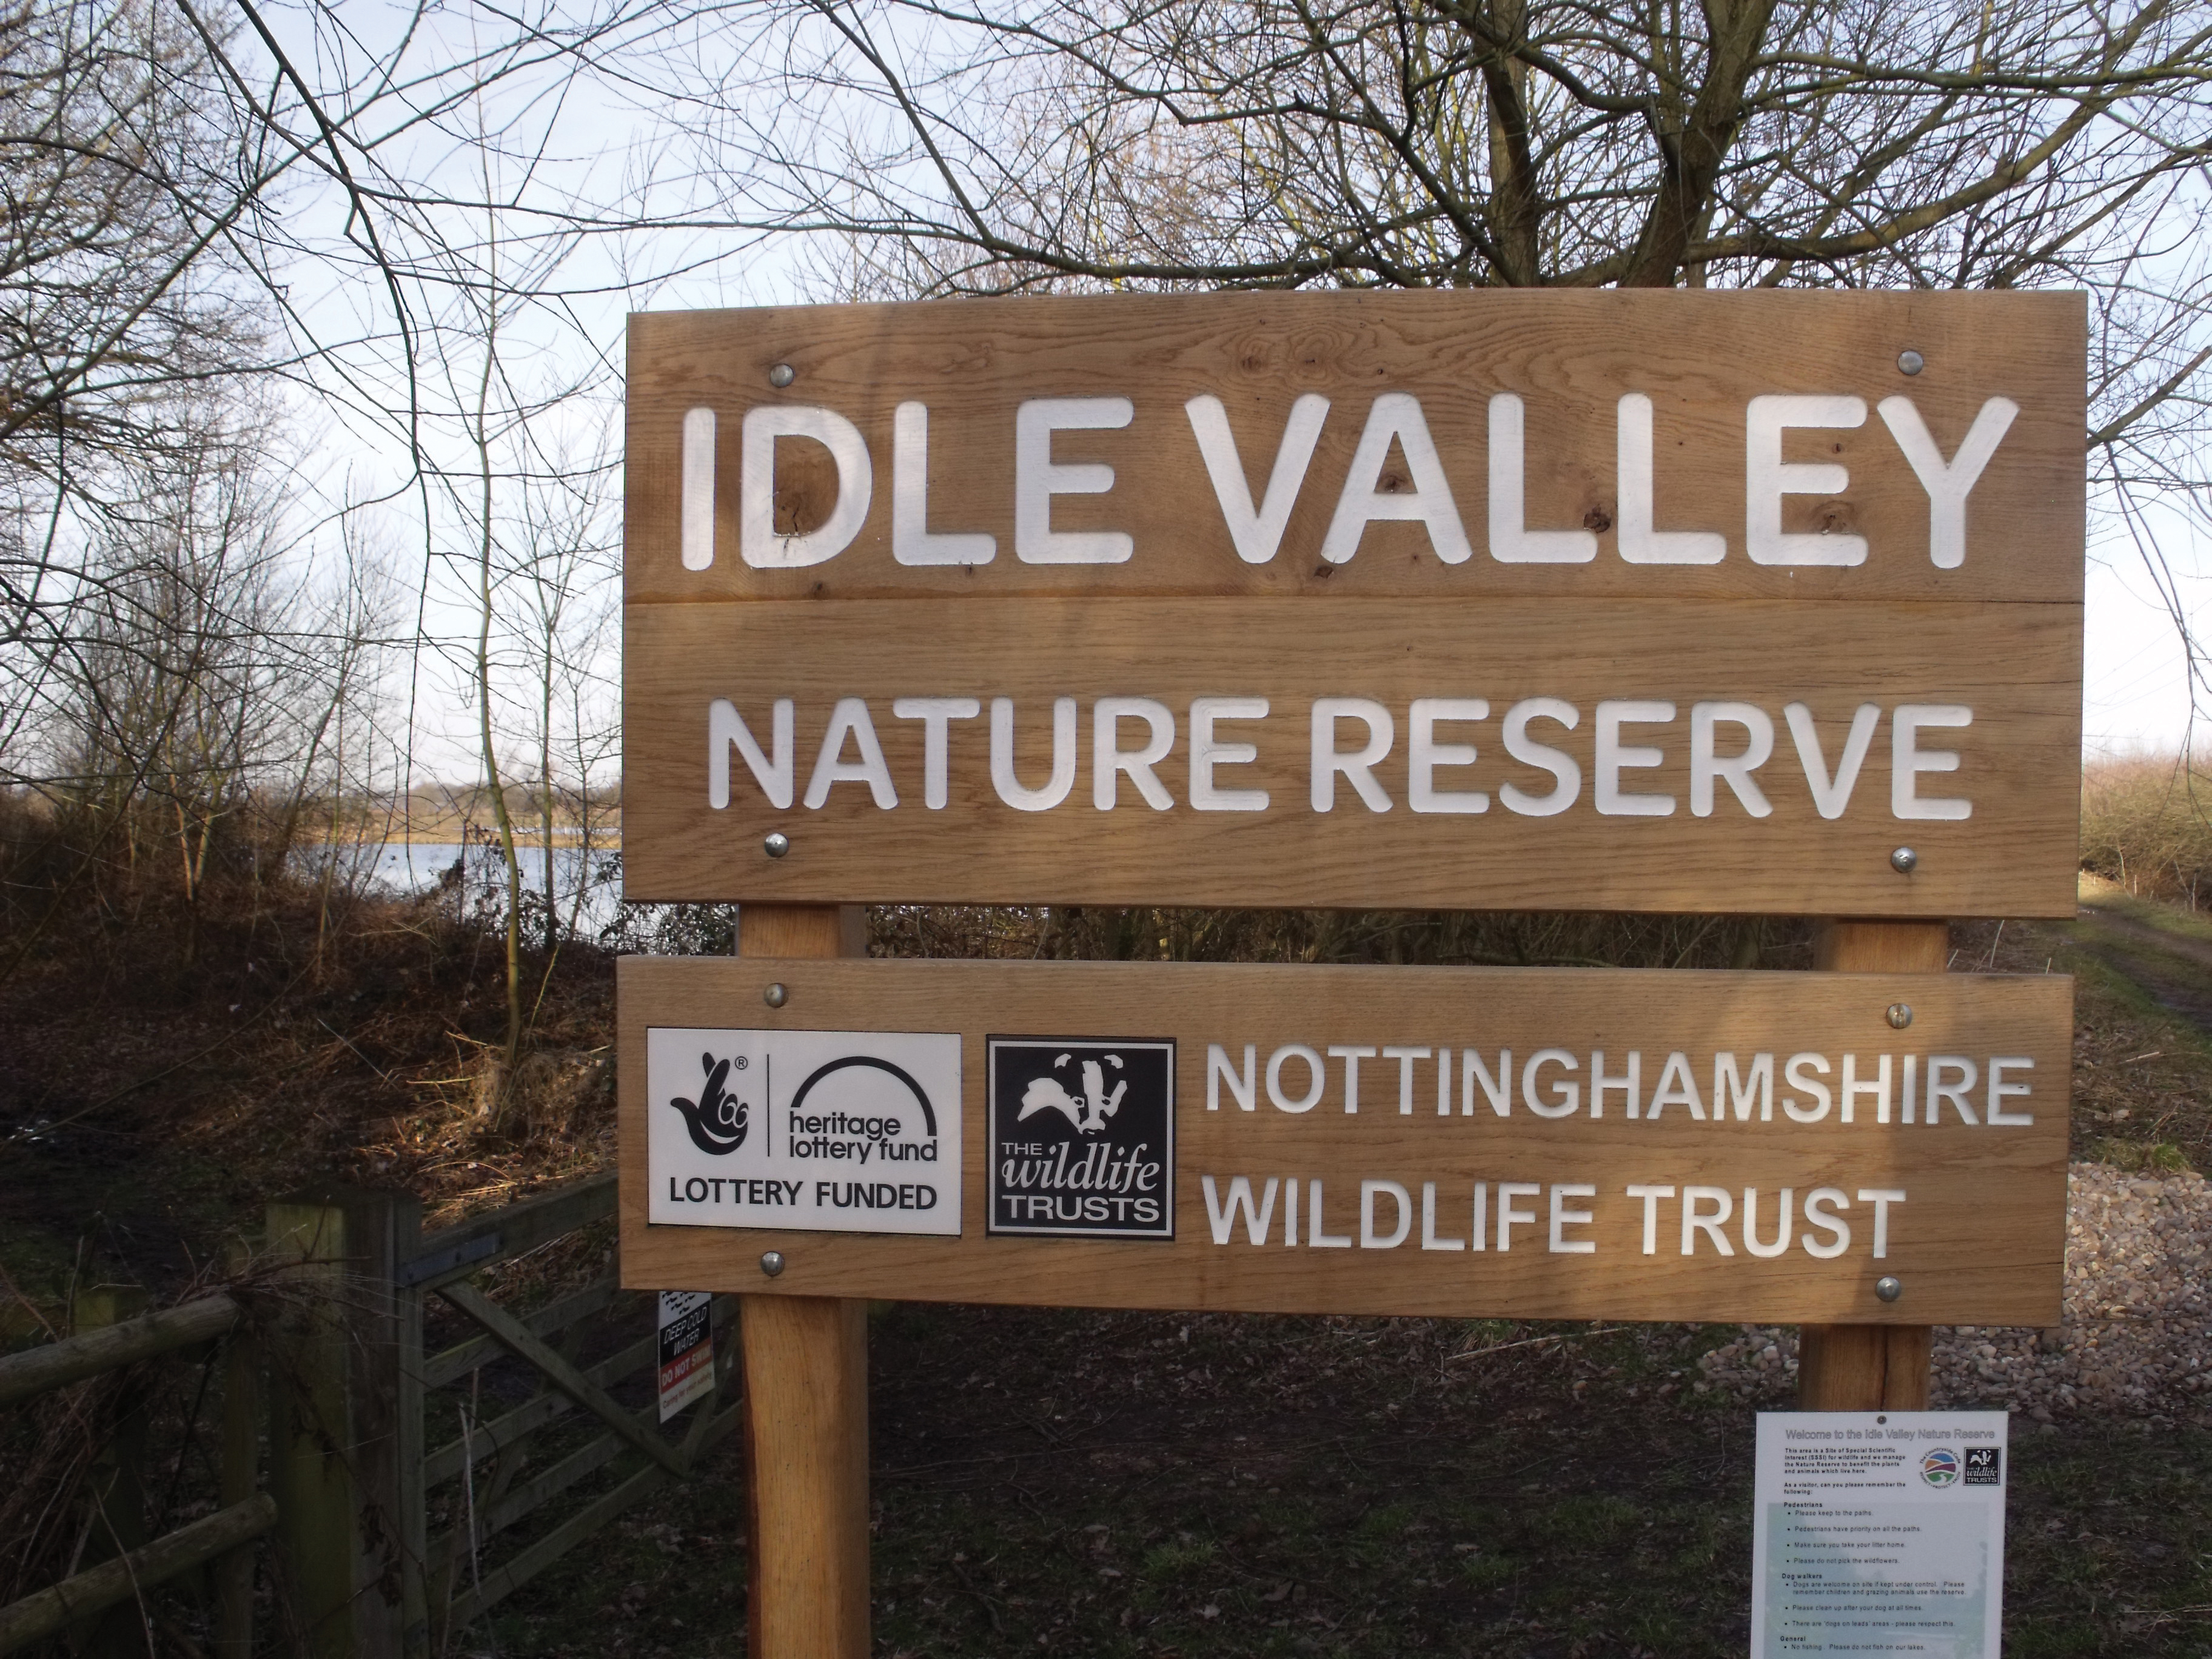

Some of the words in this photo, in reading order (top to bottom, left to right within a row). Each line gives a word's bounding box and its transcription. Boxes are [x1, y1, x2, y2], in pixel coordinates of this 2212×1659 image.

[682, 397, 1134, 571] IDLE
[1184, 393, 2020, 569] VALLEY
[708, 696, 1270, 812] NATURE
[1310, 696, 1973, 820] RESERVE
[1207, 1044, 2034, 1126] NOTTINGHAMSHIRE
[789, 1110, 901, 1141] heritage
[789, 1138, 873, 1164] lottery
[879, 1139, 937, 1162] fund
[1002, 1142, 1042, 1156] THE
[1001, 1141, 1159, 1195] wildlife
[670, 1177, 802, 1206] LOTTERY
[817, 1181, 937, 1210] FUNDED
[1002, 1195, 1160, 1223] TRUSTS
[1202, 1176, 1596, 1253] WILDLIFE
[1627, 1185, 1906, 1259] TRUST
[664, 1319, 686, 1344] DEEP
[688, 1307, 707, 1330] COLD
[674, 1328, 699, 1356] WATER
[662, 1369, 673, 1387] DO
[675, 1358, 689, 1378] NOT
[691, 1344, 711, 1367] SWIM
[1786, 1430, 1831, 1439] Welcome
[1834, 1430, 1843, 1439] to
[1847, 1430, 1862, 1439] the
[1865, 1430, 1883, 1439] Idle
[1886, 1429, 1915, 1441] Valley
[1918, 1429, 1951, 1439] Nature
[1954, 1429, 1994, 1439] Reserve
[1966, 1467, 1997, 1476] wildlife
